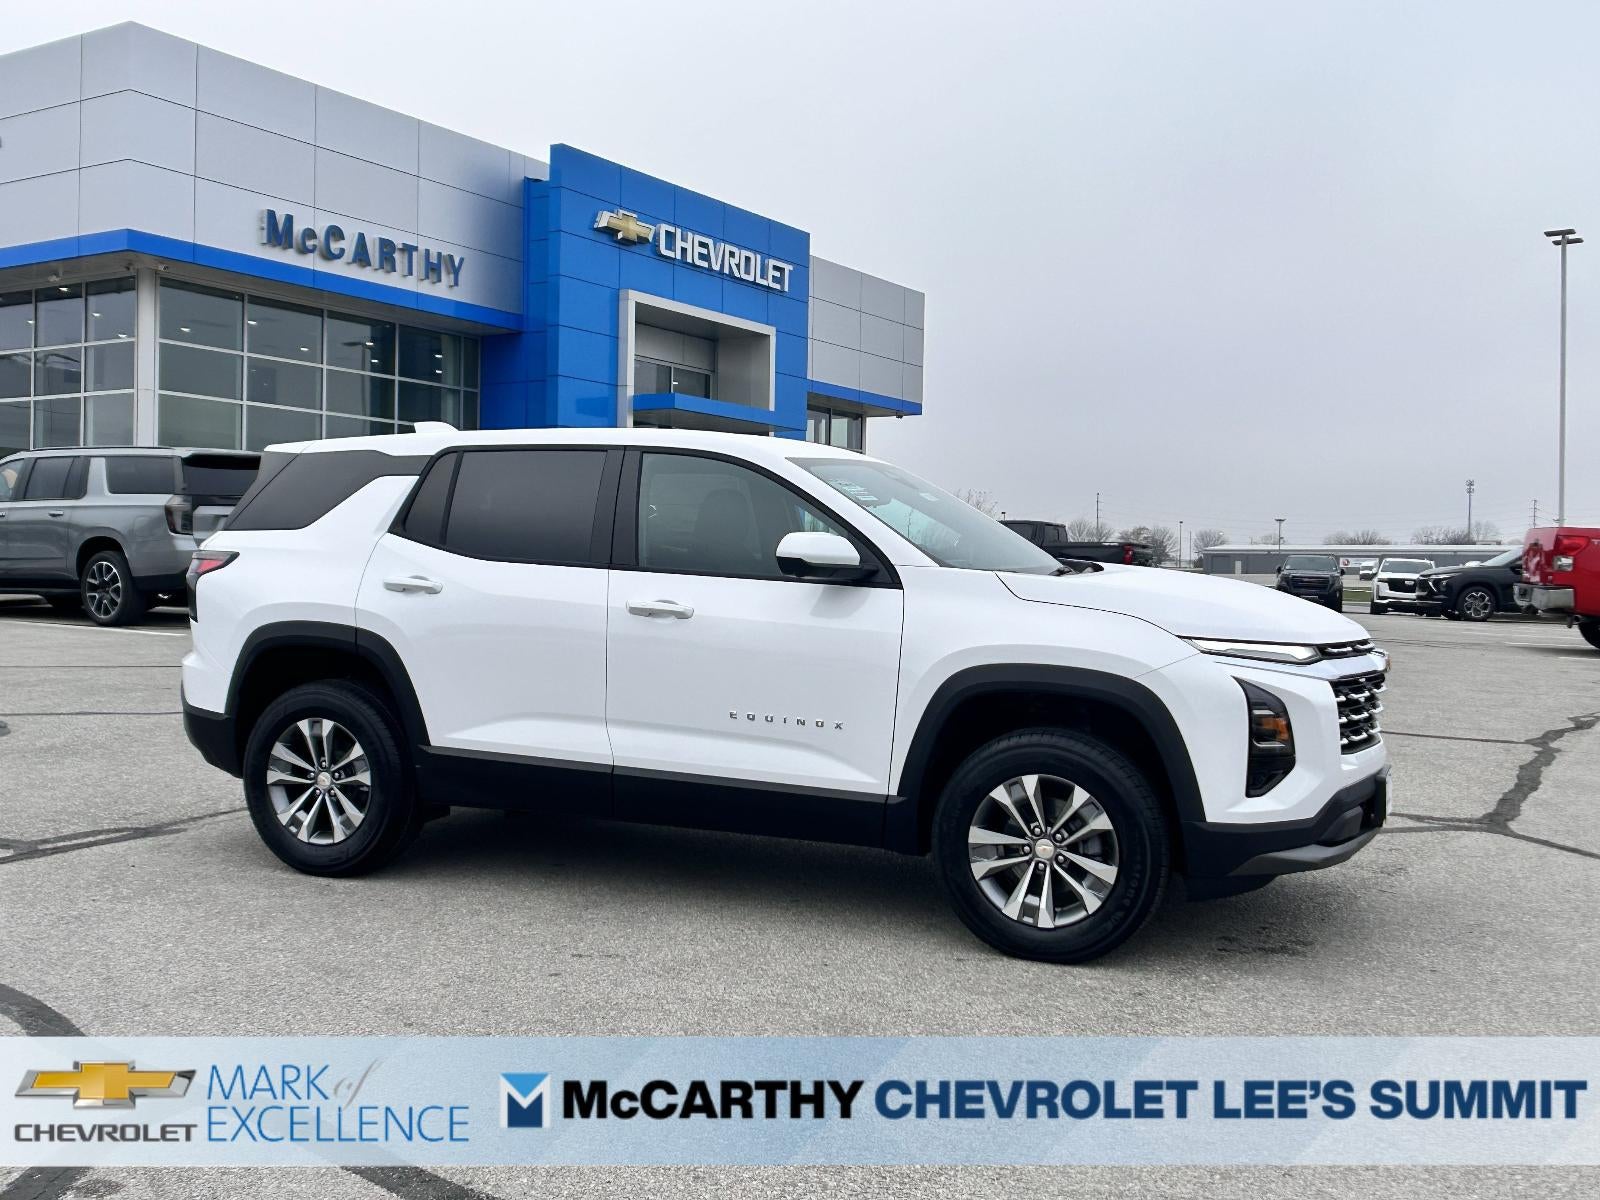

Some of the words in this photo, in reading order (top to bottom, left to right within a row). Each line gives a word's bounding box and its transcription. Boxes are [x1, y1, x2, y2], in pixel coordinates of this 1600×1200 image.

[260, 208, 465, 288] McCARTHY
[657, 223, 793, 292] CHEVROLET
[729, 710, 844, 730] EQUINOX
